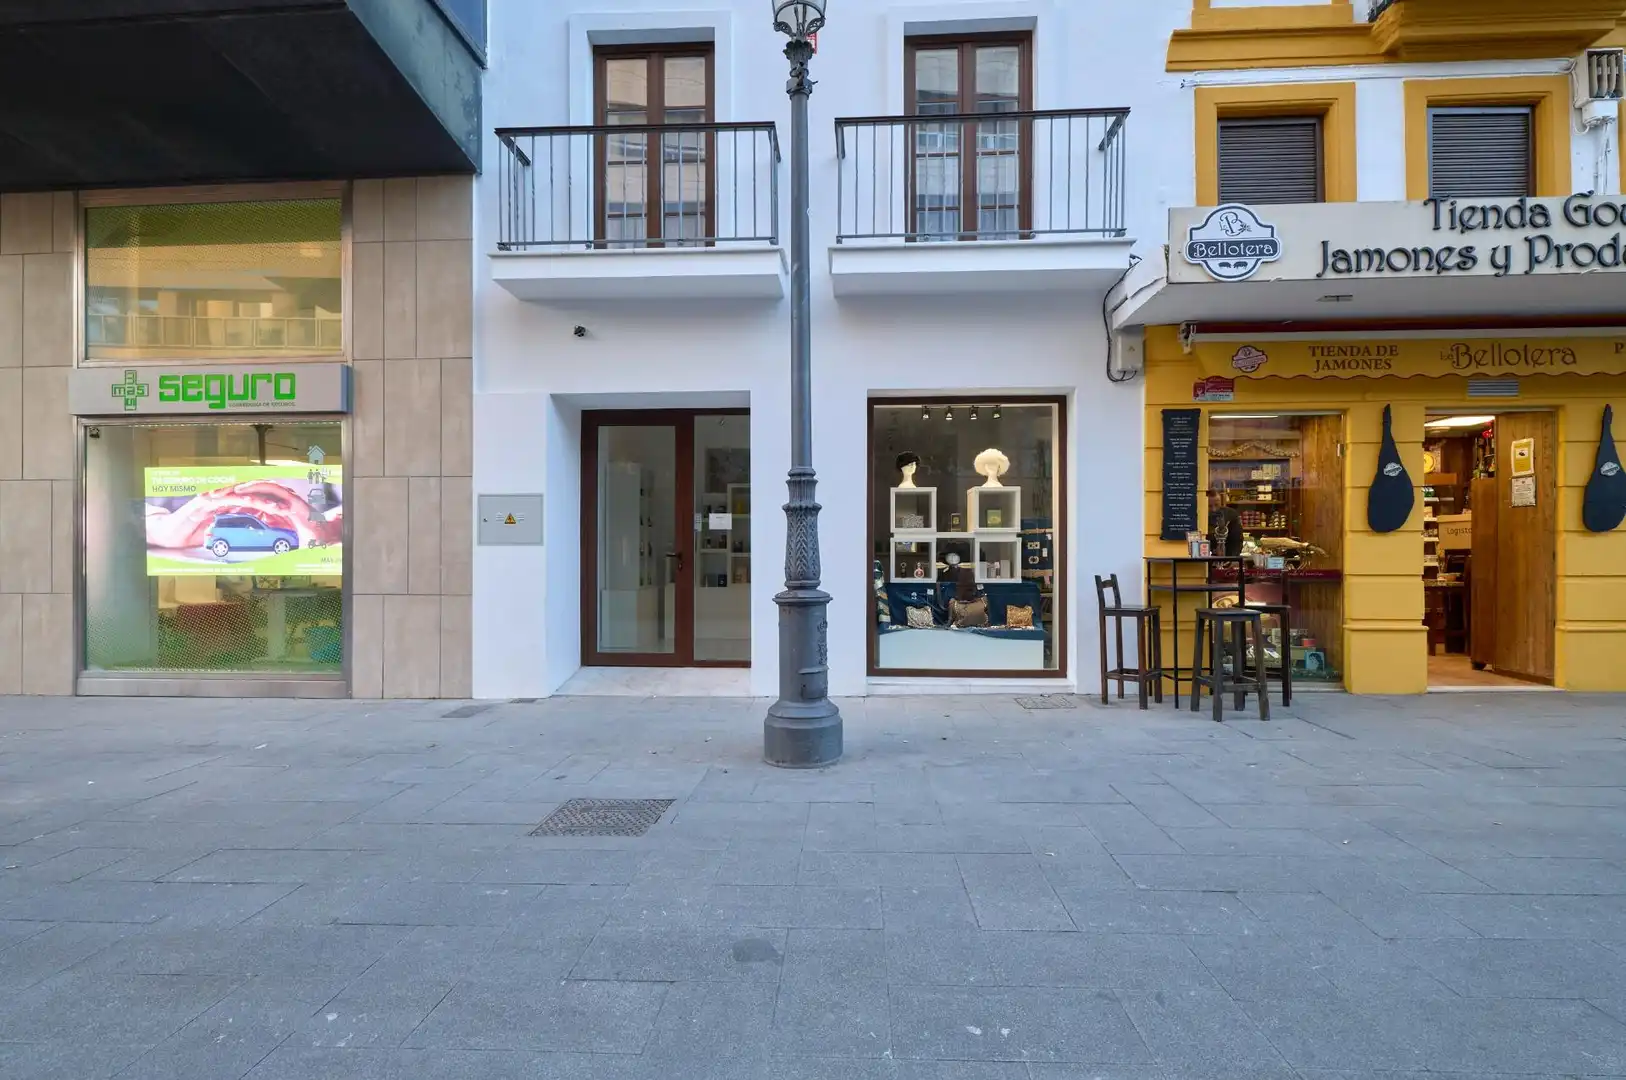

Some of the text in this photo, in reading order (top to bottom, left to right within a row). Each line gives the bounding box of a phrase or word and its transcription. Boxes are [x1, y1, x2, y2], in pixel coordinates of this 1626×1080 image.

[1423, 194, 1552, 233] Tienda
[1193, 242, 1274, 258] Bellotera
[1316, 232, 1626, 278] Jamones y Prod
[1308, 345, 1399, 357] TIENDA DE
[1451, 342, 1578, 369] Bellotera
[1314, 358, 1392, 373] JAMONES
[158, 372, 296, 409] seguro
